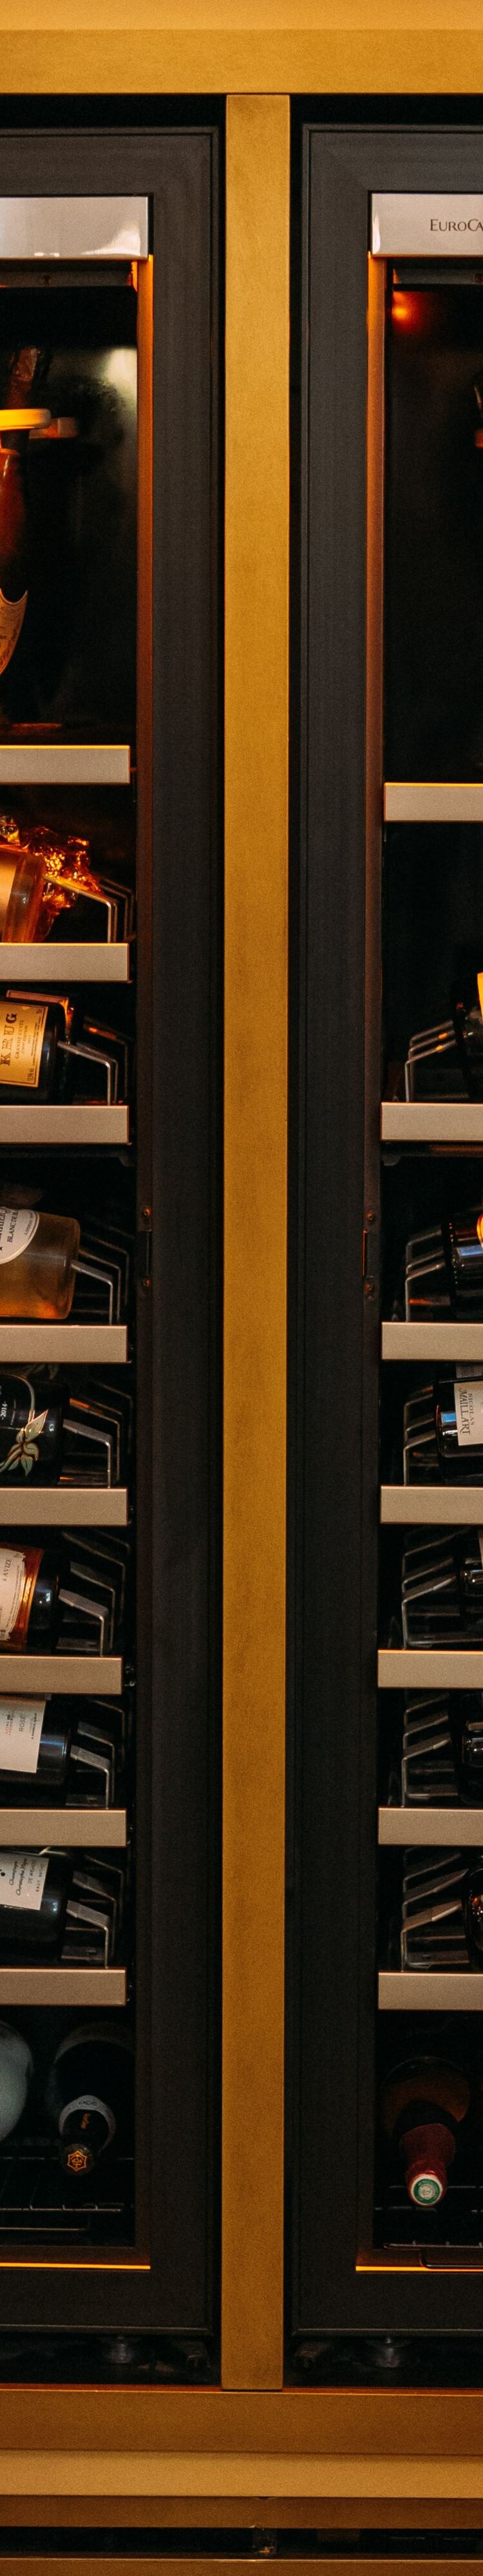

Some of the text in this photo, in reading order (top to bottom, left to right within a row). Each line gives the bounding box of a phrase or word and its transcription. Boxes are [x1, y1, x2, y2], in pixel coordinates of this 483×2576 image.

[0, 1013, 17, 1066] KRUG
[6, 1222, 16, 1243] BLANC
[459, 1387, 471, 1436] MAILLART
[3, 1558, 12, 1577] AVIZE
